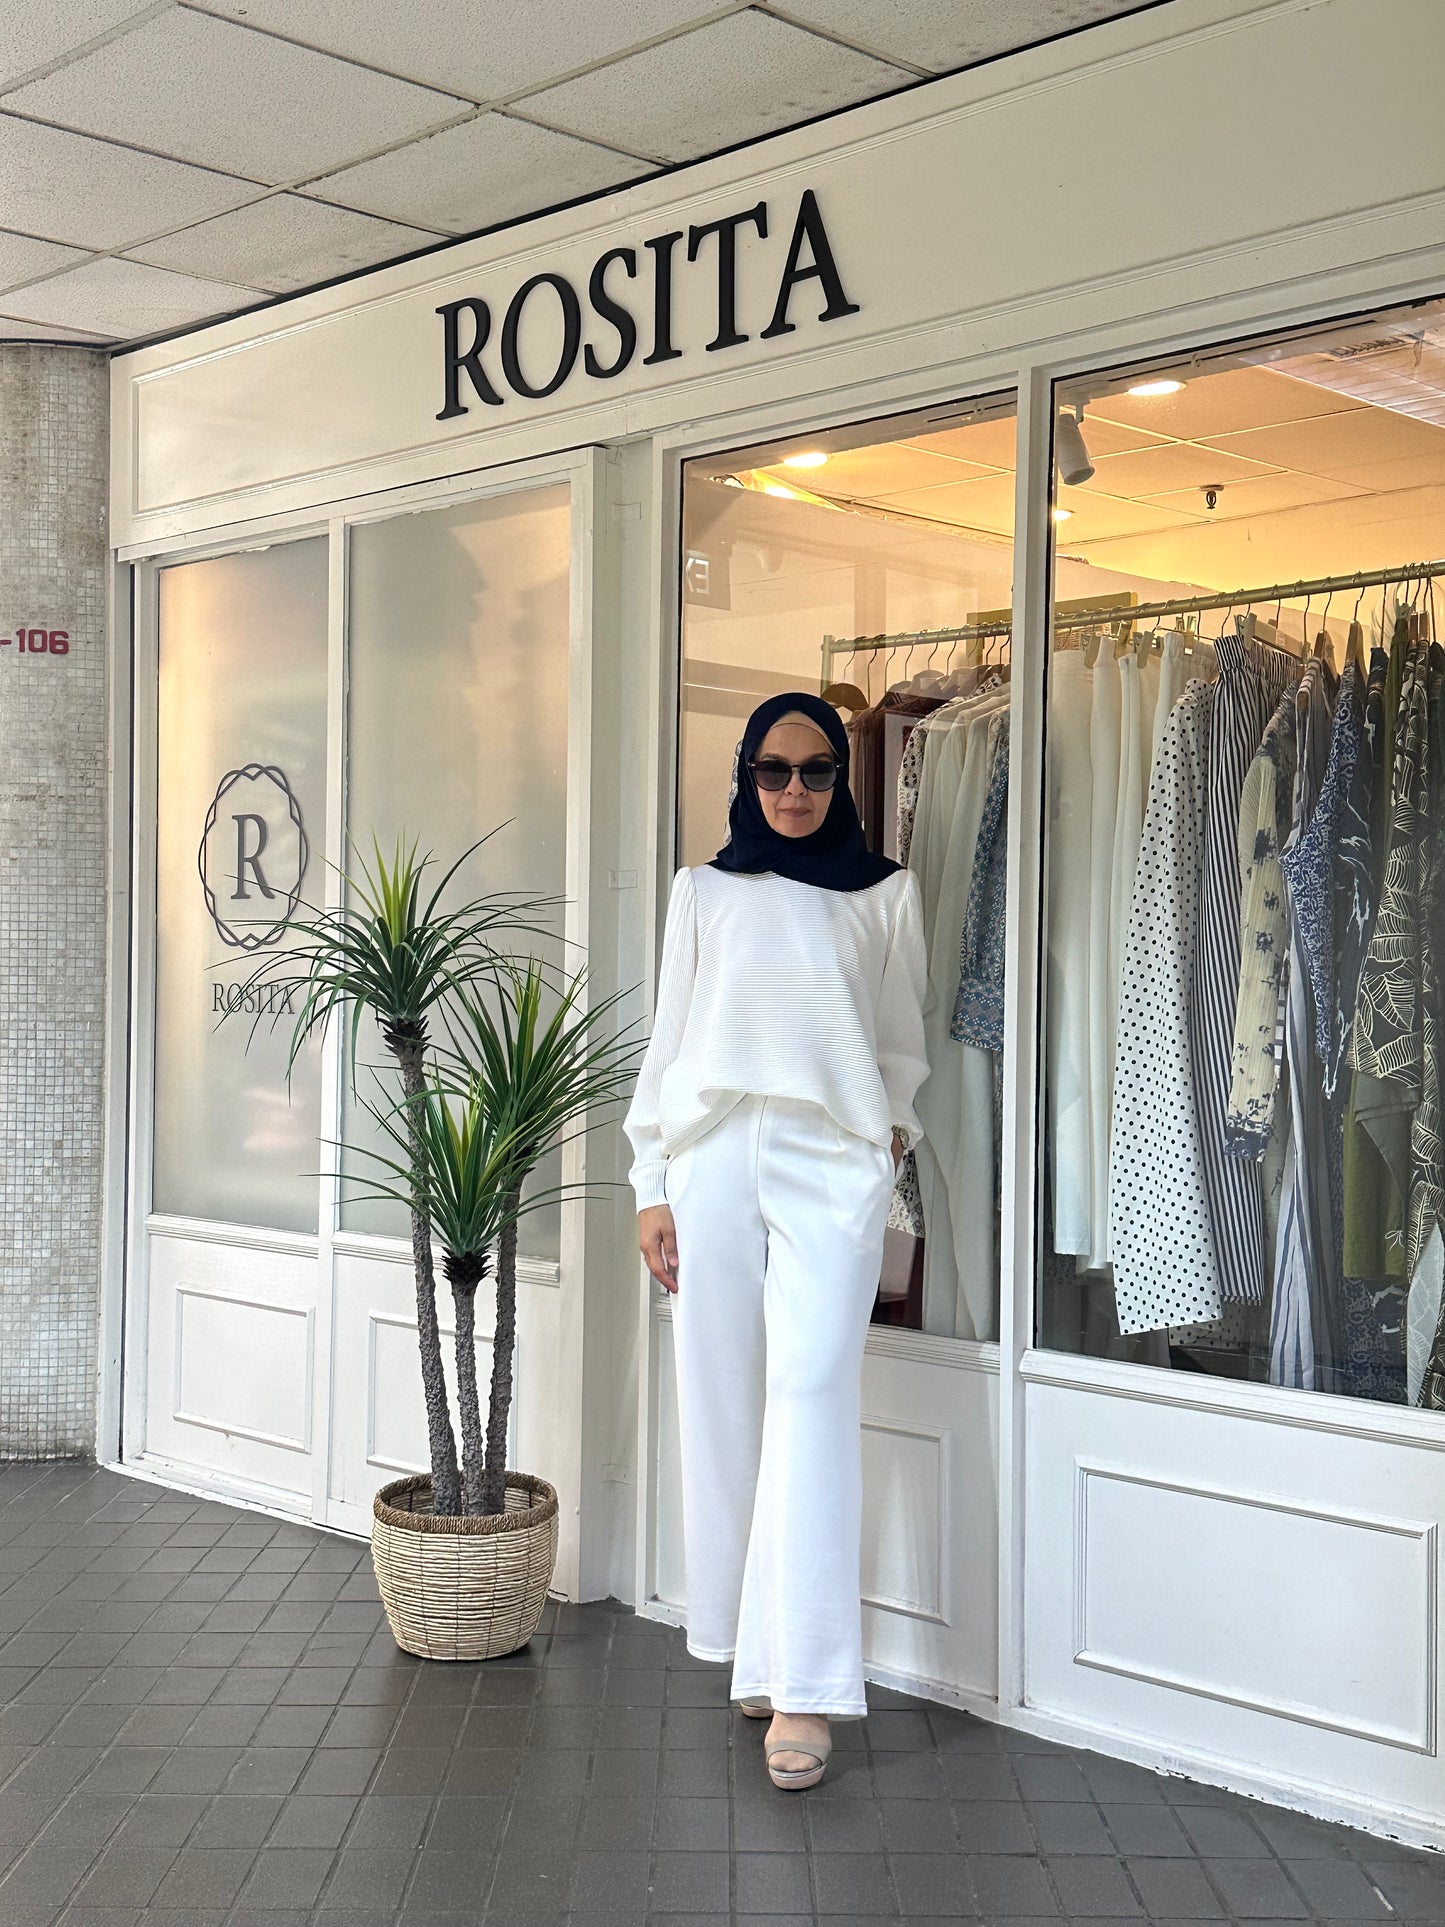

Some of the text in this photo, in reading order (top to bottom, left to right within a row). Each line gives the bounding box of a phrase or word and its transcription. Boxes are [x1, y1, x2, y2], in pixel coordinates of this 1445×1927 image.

[435, 189, 860, 421] ROSITA
[231, 814, 275, 900] R
[212, 983, 294, 1014] ROSITA
